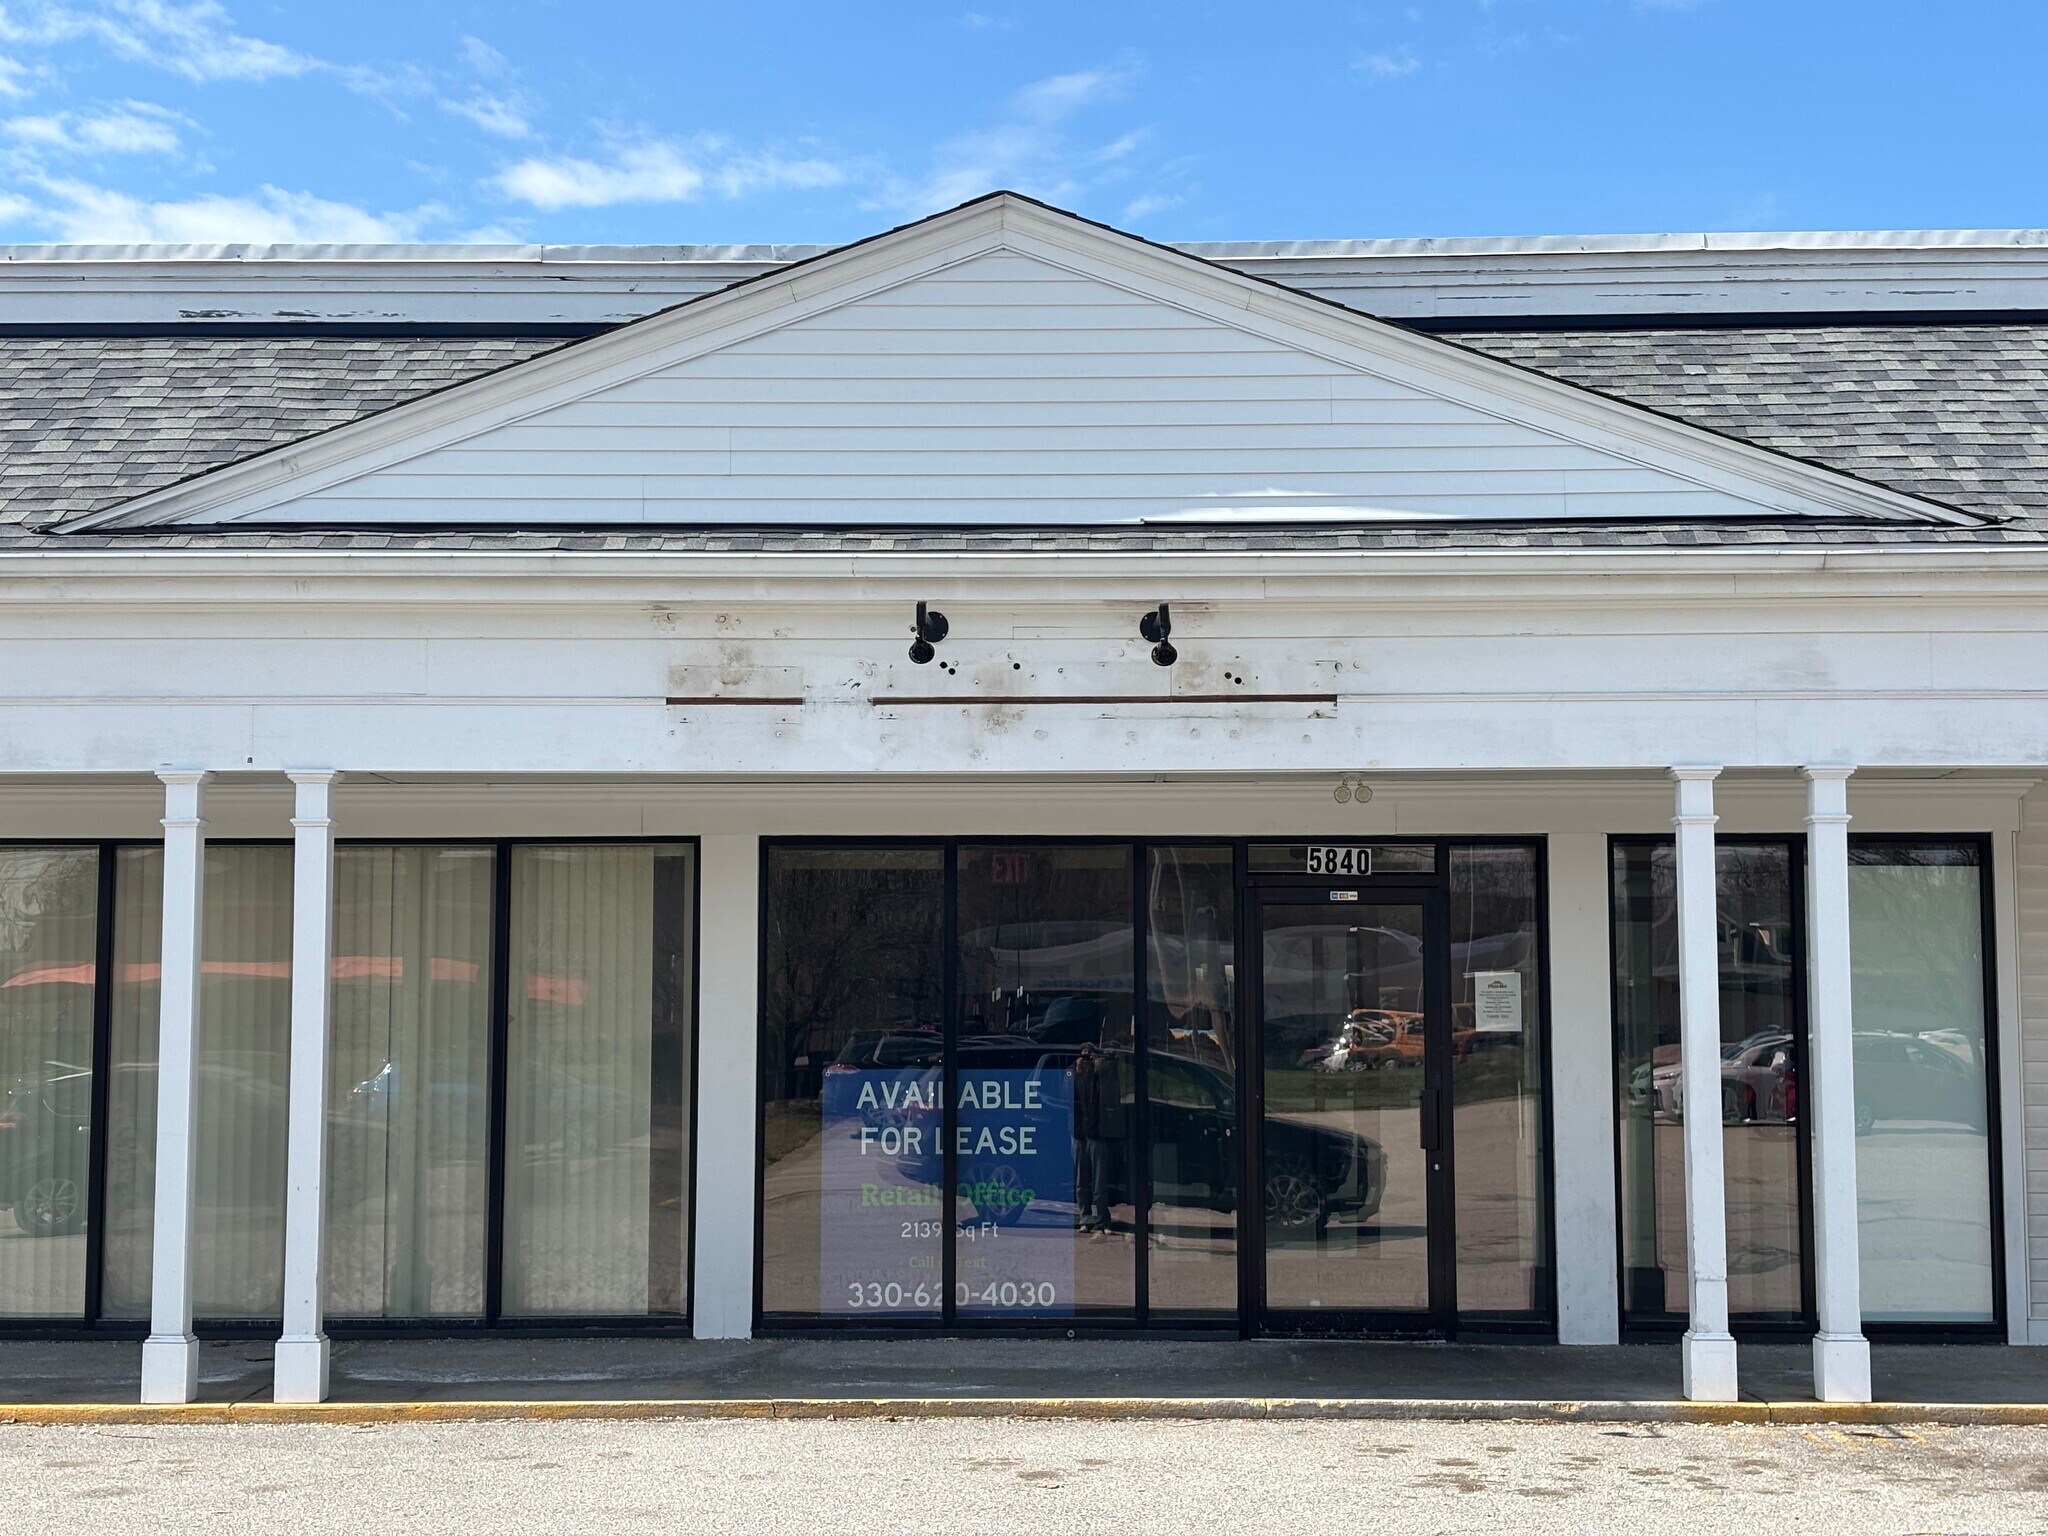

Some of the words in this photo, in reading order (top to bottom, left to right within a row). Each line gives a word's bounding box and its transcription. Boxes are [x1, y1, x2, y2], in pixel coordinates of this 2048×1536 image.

[1308, 847, 1370, 874] 5840
[861, 1127, 922, 1155] FOR
[935, 1127, 1037, 1155] LEASE
[861, 1183, 941, 1206] Retail
[901, 1222, 943, 1238] 2139
[955, 1222, 975, 1242] Sq
[982, 1222, 999, 1238] Ft
[909, 1256, 934, 1268] Call
[848, 1282, 1055, 1307] 330-620-4030
